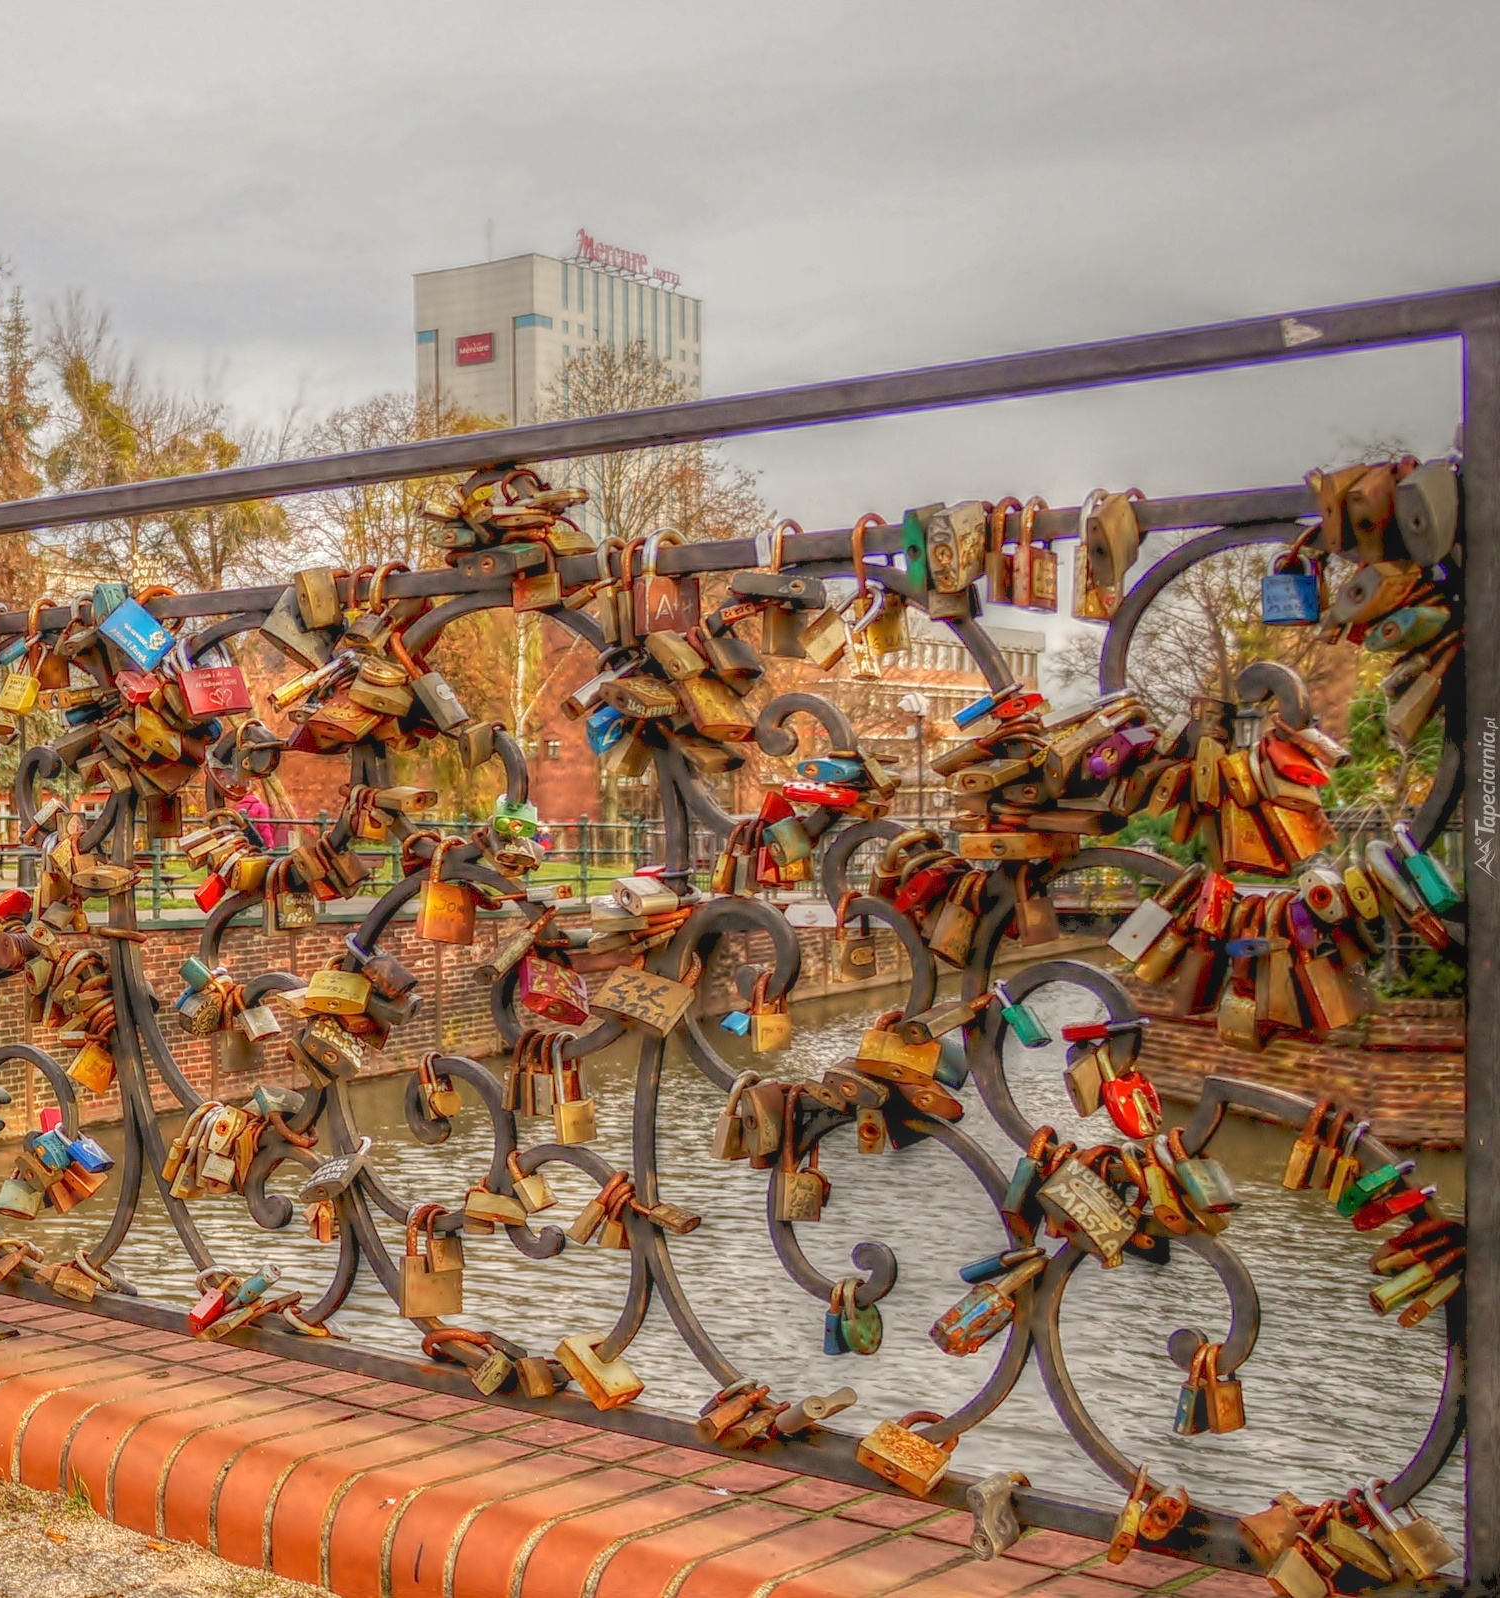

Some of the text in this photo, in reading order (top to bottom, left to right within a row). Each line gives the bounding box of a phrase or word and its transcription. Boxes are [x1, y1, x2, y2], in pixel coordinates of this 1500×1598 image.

[576, 227, 681, 287] Mercure HOTEL
[459, 344, 490, 355] Mercure
[1042, 1182, 1120, 1258] MASZA
